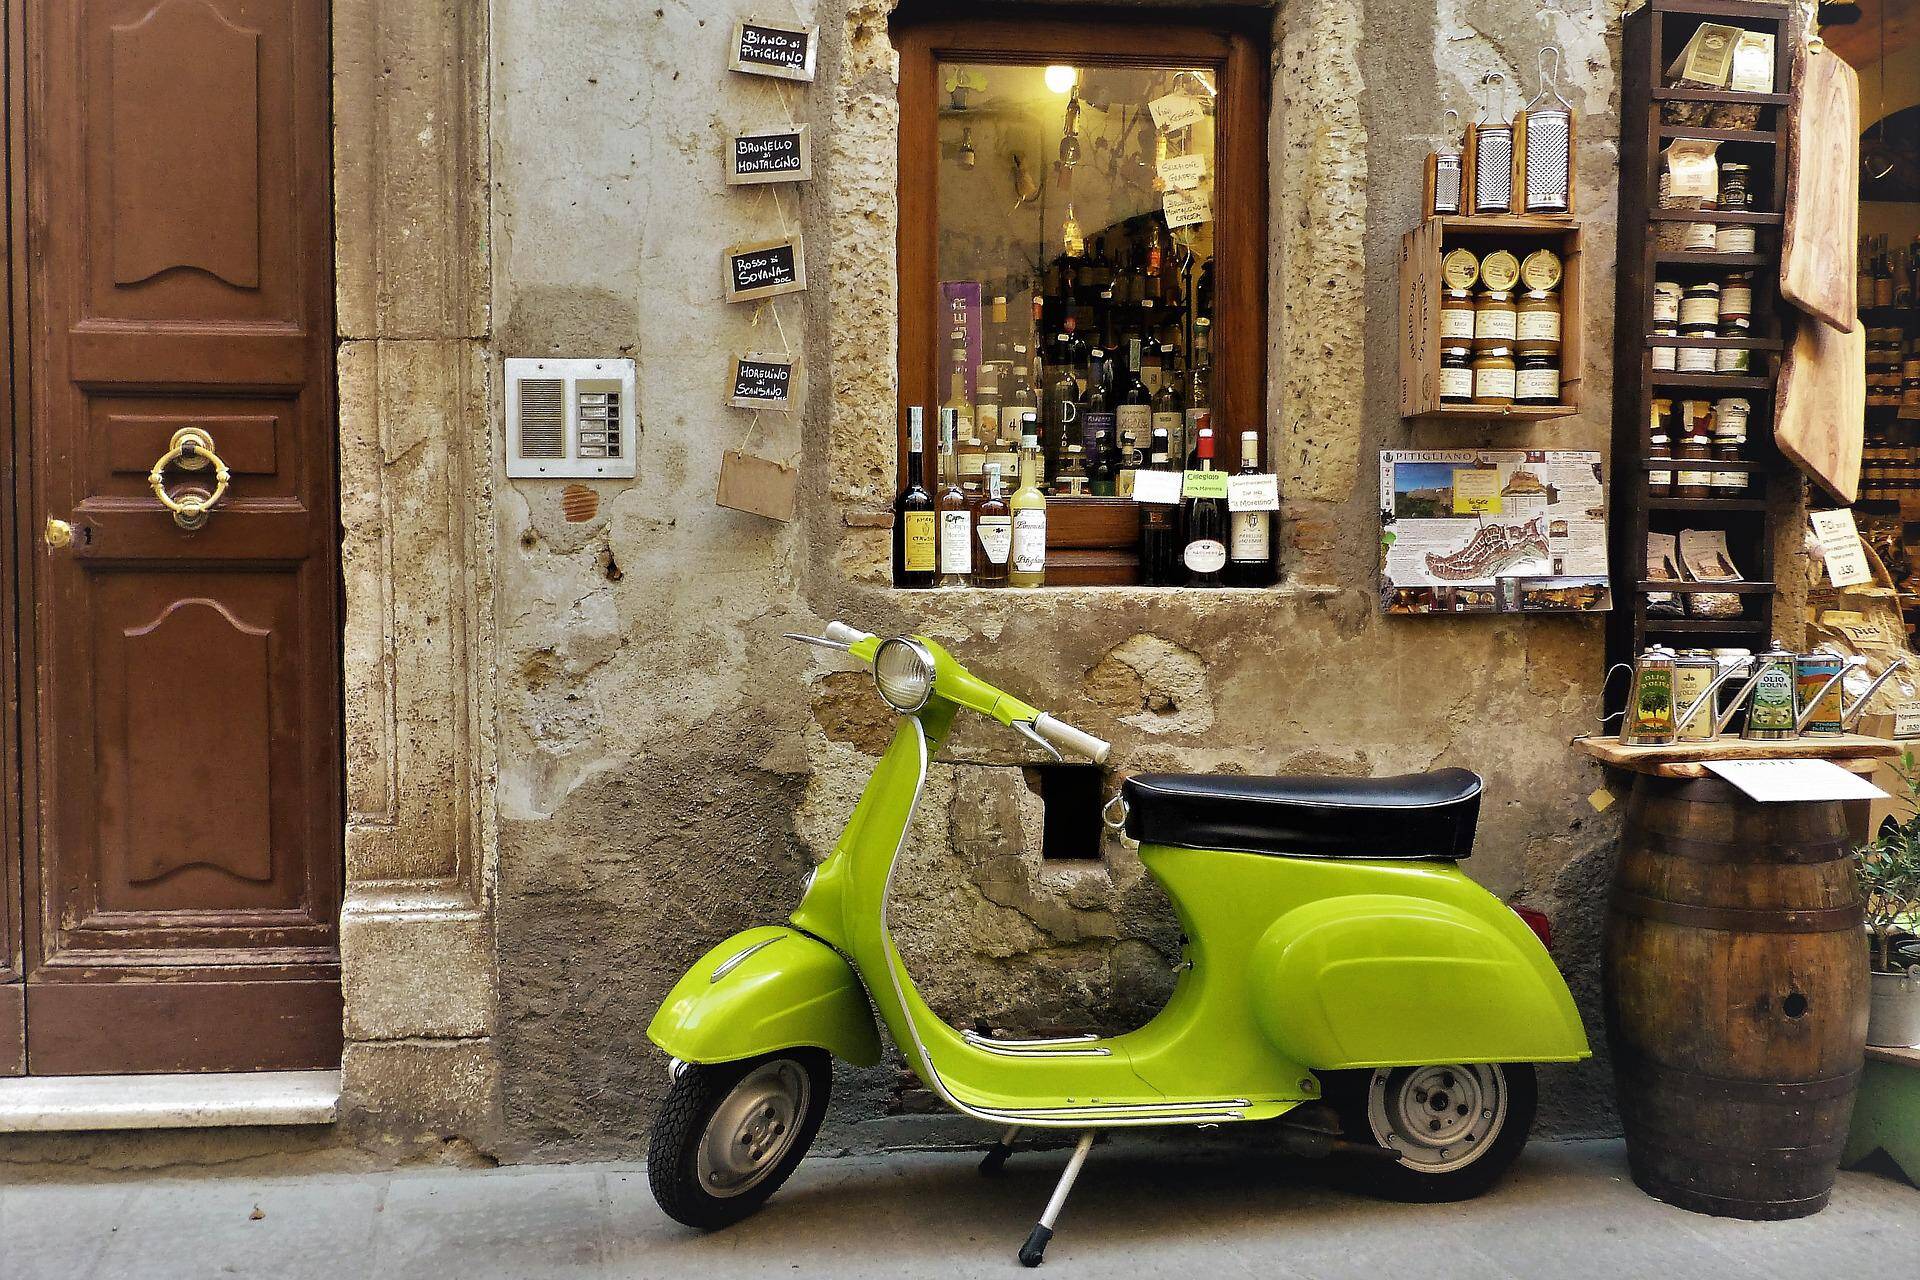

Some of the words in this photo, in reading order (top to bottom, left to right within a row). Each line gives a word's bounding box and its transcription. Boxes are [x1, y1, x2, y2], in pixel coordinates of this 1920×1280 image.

[738, 140, 793, 154] BRUNELLO
[738, 266, 790, 285] SOVANA
[773, 276, 792, 284] DOC
[1396, 452, 1472, 461] PITIGLIANO
